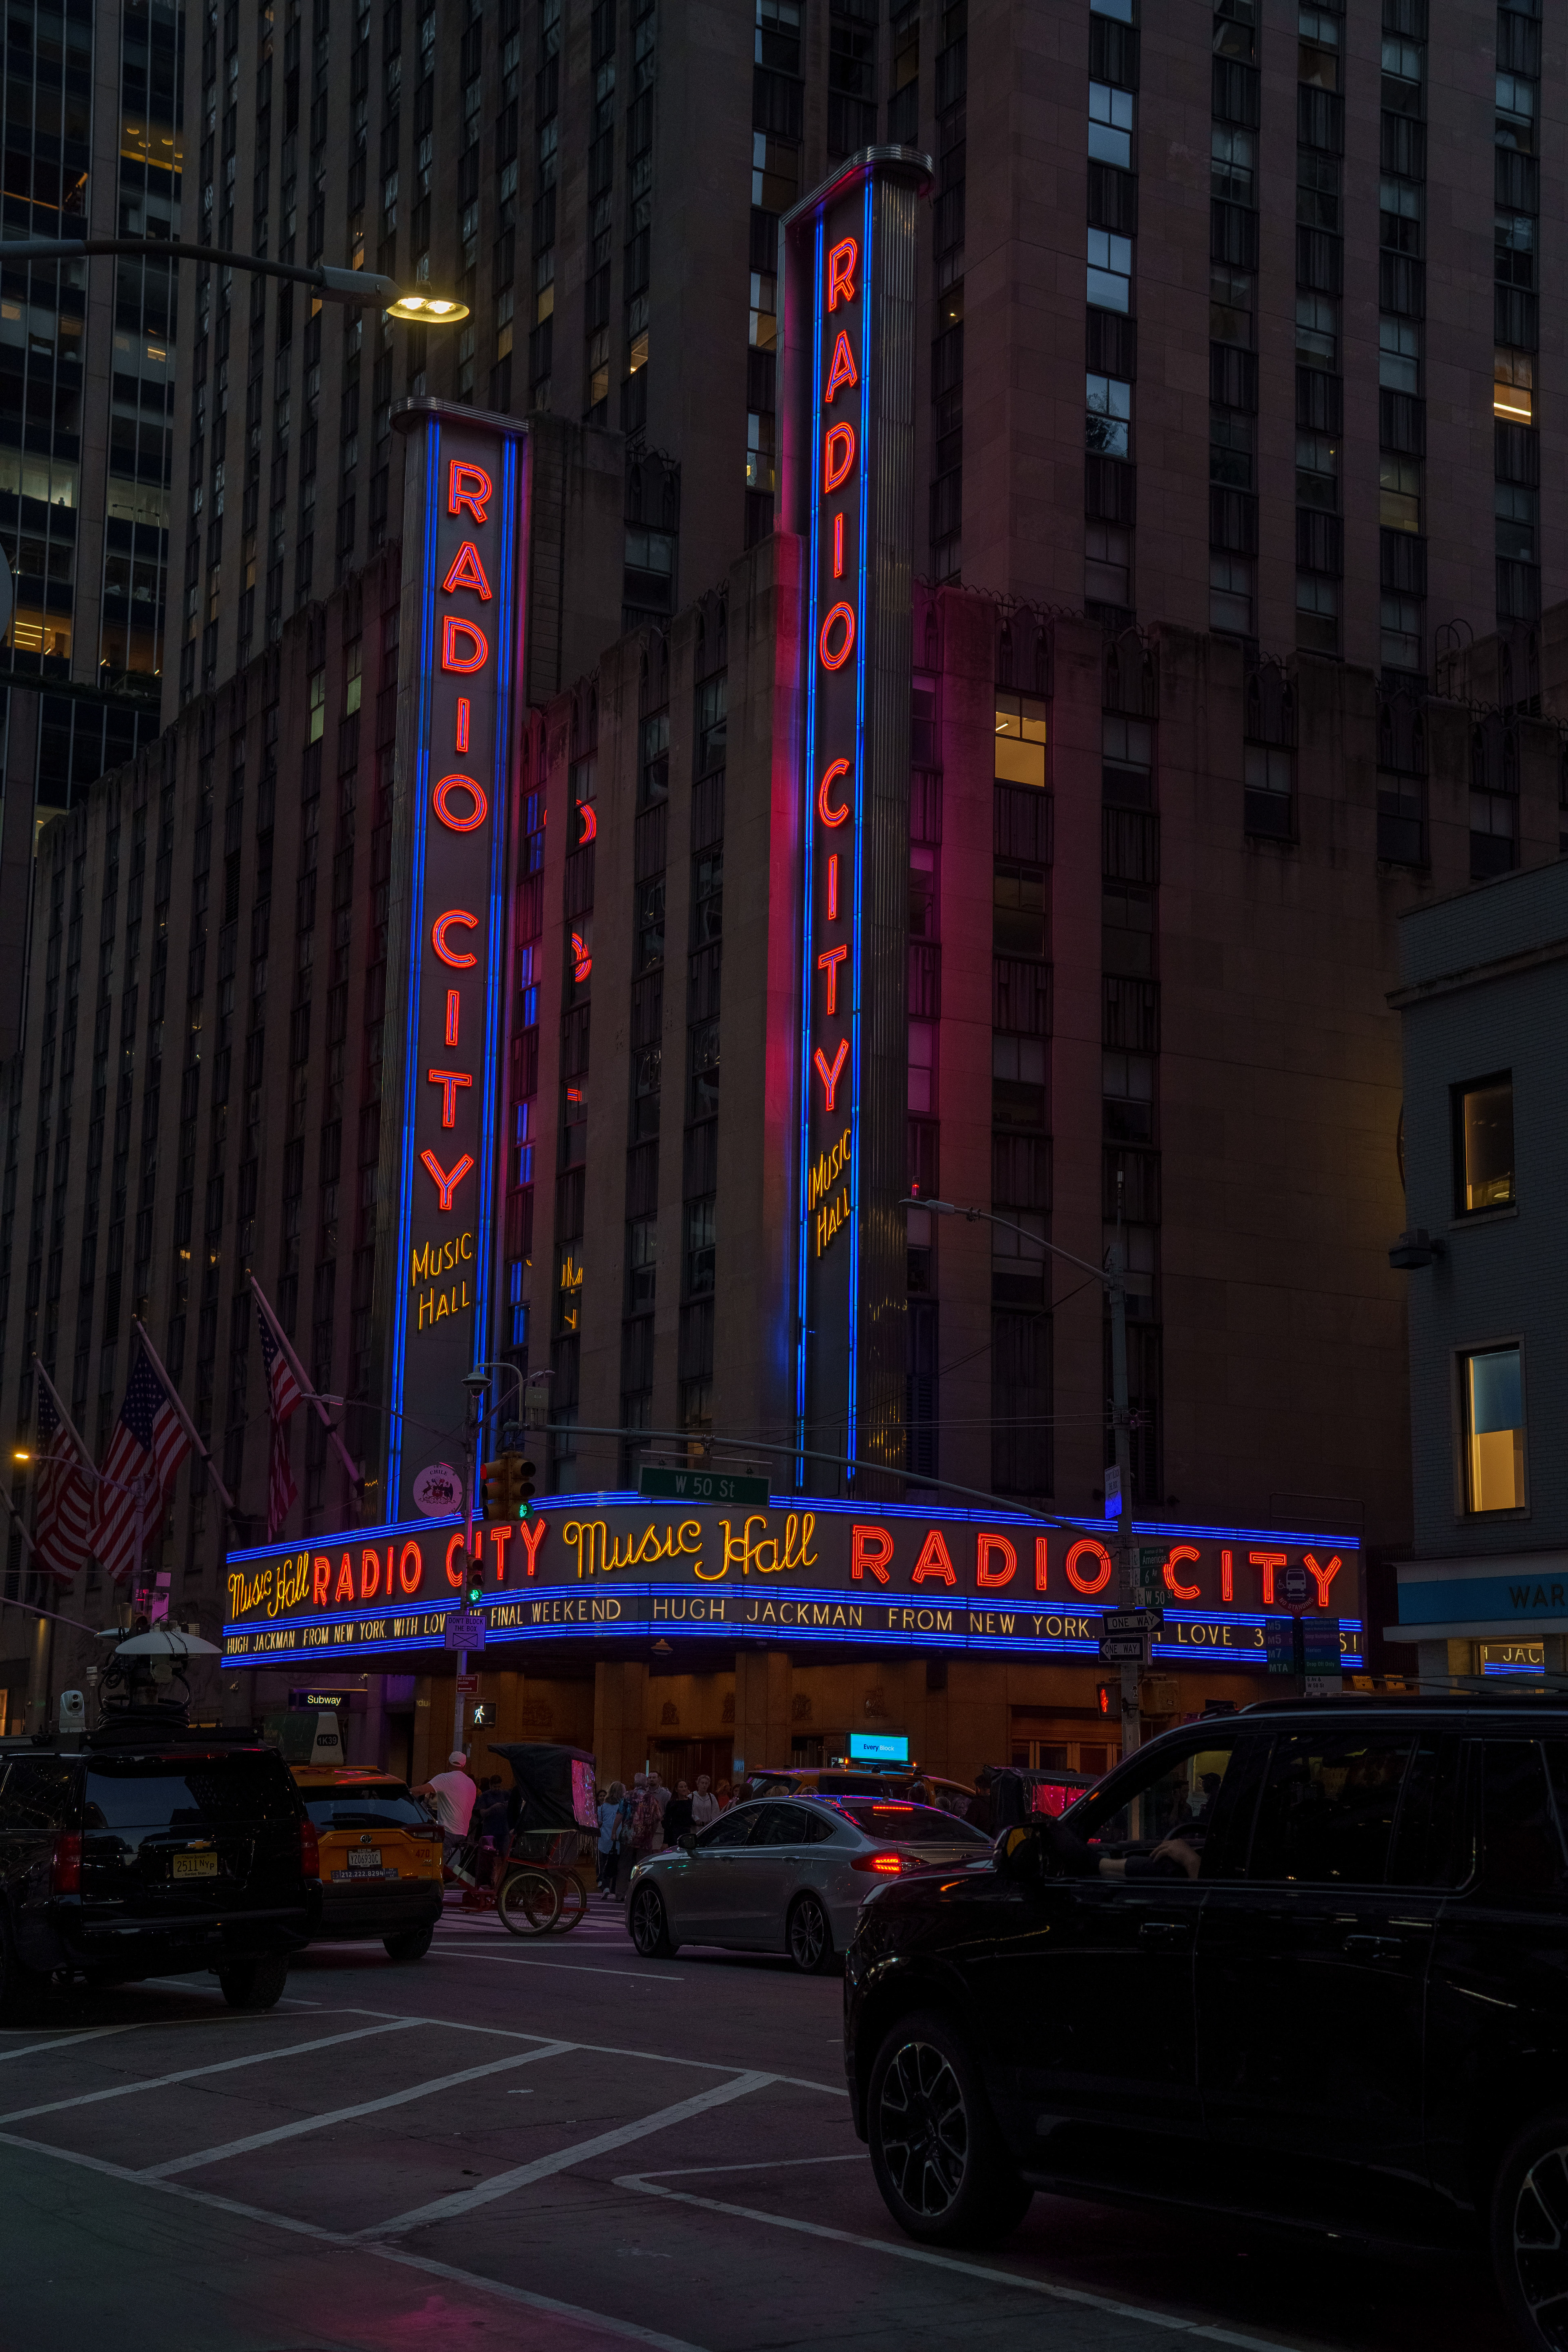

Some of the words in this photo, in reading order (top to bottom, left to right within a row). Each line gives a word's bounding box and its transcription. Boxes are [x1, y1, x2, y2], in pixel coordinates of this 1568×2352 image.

[820, 237, 858, 671] RADIO
[432, 459, 492, 832] RADIO
[813, 758, 850, 1112] CITY
[420, 909, 479, 1211] CITY
[676, 1475, 687, 1493] W
[693, 1477, 712, 1495] 50
[719, 1480, 735, 1498] St
[563, 1519, 703, 1579] Music
[694, 1511, 819, 1581] Hall
[851, 1524, 1112, 1594] RADIO
[1163, 1545, 1343, 1607] CITY
[1143, 1554, 1167, 1565] Americas
[313, 1540, 422, 1606] RADIO
[1145, 1569, 1149, 1584] 6
[1152, 1568, 1157, 1577] Av
[228, 1569, 273, 1620] Music
[267, 1550, 310, 1618] Hall
[1146, 1590, 1152, 1604] W
[1155, 1591, 1165, 1605] 50
[1167, 1590, 1173, 1599] St
[1279, 1597, 1287, 1606] NO
[1288, 1597, 1314, 1610] STANDING
[1509, 1584, 1565, 1608] WAR
[227, 1636, 248, 1654] HUGH
[253, 1630, 295, 1651] JACKMAN
[303, 1626, 329, 1646] FROM
[334, 1624, 354, 1643] NEW
[360, 1620, 387, 1640] YORK.
[394, 1617, 418, 1637] WITH
[424, 1612, 451, 1634] LOV
[491, 1605, 523, 1627] FINAL
[532, 1599, 621, 1623] WEEKEND
[654, 1599, 724, 1620] HUGH
[746, 1601, 862, 1626] JACKMAN
[889, 1608, 952, 1630] FROM
[970, 1613, 1015, 1634] NEW
[1033, 1615, 1095, 1639] YORK.
[1178, 1624, 1232, 1646] LOVE
[1254, 1628, 1264, 1647] 3
[1112, 1618, 1129, 1628] ONE
[1137, 1616, 1154, 1626] WAY
[1267, 1620, 1281, 1630] M5
[1267, 1634, 1282, 1644] M5
[1105, 1644, 1118, 1654] ONE
[1123, 1644, 1137, 1653] WAY
[1268, 1648, 1281, 1658] M7
[1503, 1648, 1544, 1664] JAC
[1269, 1664, 1288, 1673] MTA
[307, 1695, 341, 1706] Subway
[318, 1736, 337, 1745] 1K39
[351, 1854, 379, 1864] Y206930C
[416, 1849, 430, 1858] 470
[177, 1860, 198, 1872] 2511
